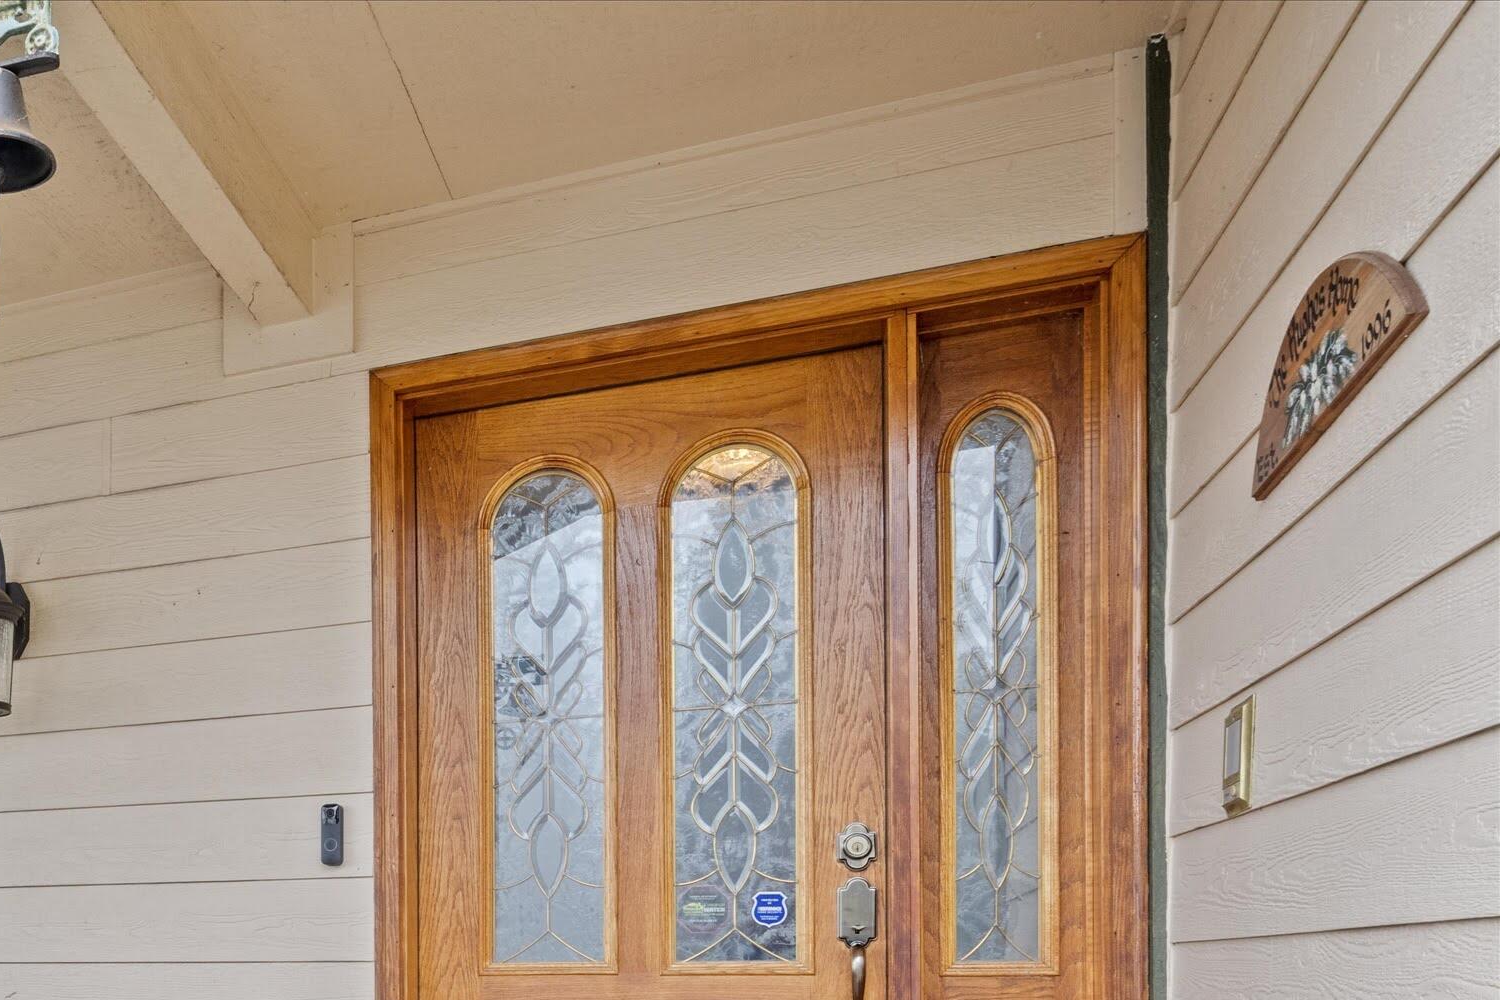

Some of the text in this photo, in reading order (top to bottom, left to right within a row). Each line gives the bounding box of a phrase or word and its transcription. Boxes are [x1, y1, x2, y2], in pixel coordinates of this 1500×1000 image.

[1268, 354, 1287, 409] The
[1287, 286, 1325, 361] Hughes
[1328, 266, 1359, 317] Home
[1361, 298, 1392, 361] 1996
